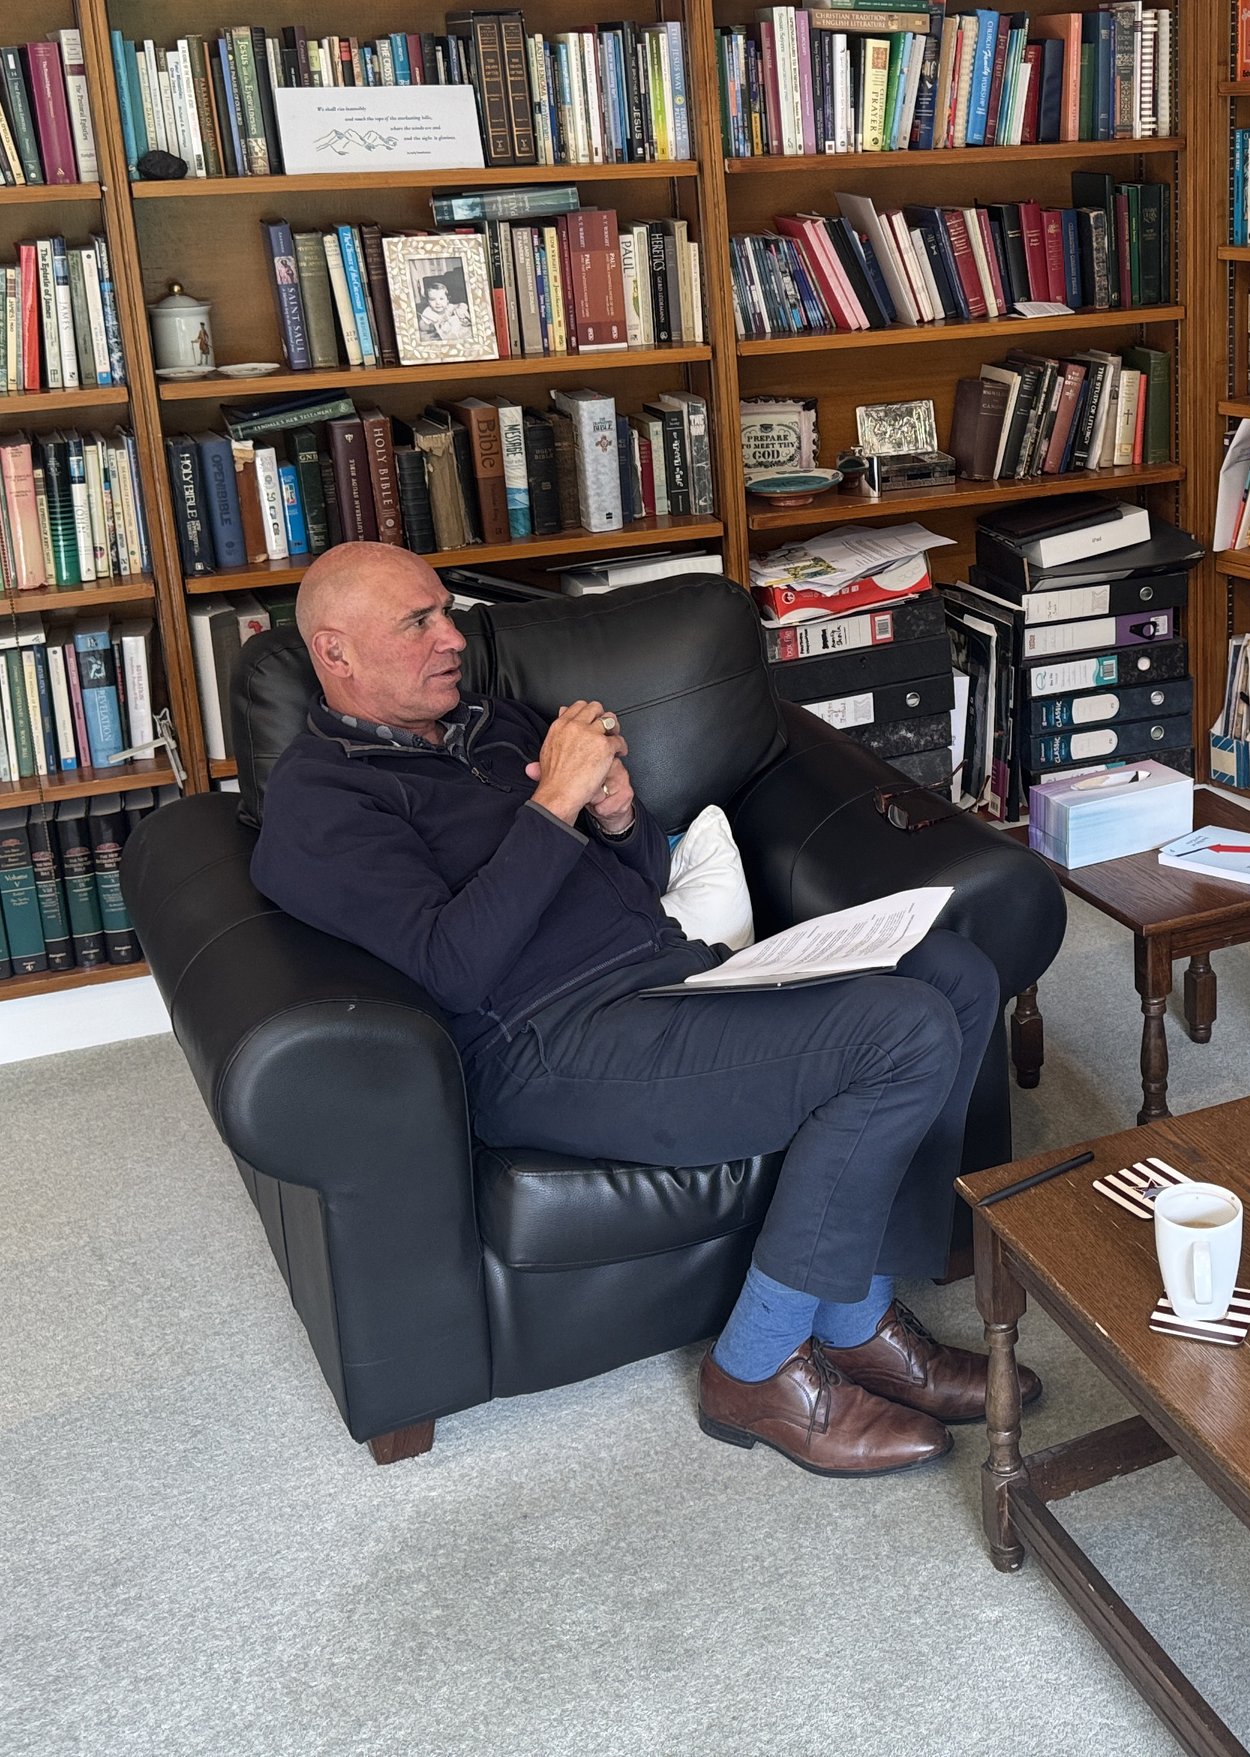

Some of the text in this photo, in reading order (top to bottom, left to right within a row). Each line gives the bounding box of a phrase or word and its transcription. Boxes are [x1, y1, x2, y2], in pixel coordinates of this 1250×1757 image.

[237, 40, 250, 65] Jesus
[380, 42, 392, 80] THE CROSS
[978, 20, 993, 106] CHURCH Family WORSHIP
[76, 94, 85, 117] Pastoral
[199, 78, 209, 115] PARABLES
[243, 84, 260, 135] Eyewitnesses
[869, 91, 878, 131] PRAYER
[79, 118, 88, 140] Epistles
[633, 106, 642, 139] JESUS
[508, 193, 518, 216] PAUL
[621, 241, 633, 272] PAUL
[651, 233, 664, 270] HERETICS
[44, 298, 52, 318] James
[59, 302, 70, 330] JAMES
[287, 287, 303, 352] SAINT SAUL
[300, 408, 333, 420] TESTAMENT
[1083, 366, 1104, 445] THE STUDY OF LITURGY
[300, 452, 318, 462] GNB
[476, 417, 500, 468] Bible
[504, 424, 522, 456] MESSAGE
[753, 450, 780, 459] GOD
[373, 428, 392, 505] HOLY BIBLE
[179, 454, 197, 518] HOLY BIBLE
[216, 490, 231, 526] BIBLE
[355, 500, 363, 532] LUTHERAN
[97, 689, 112, 741] REVELATION
